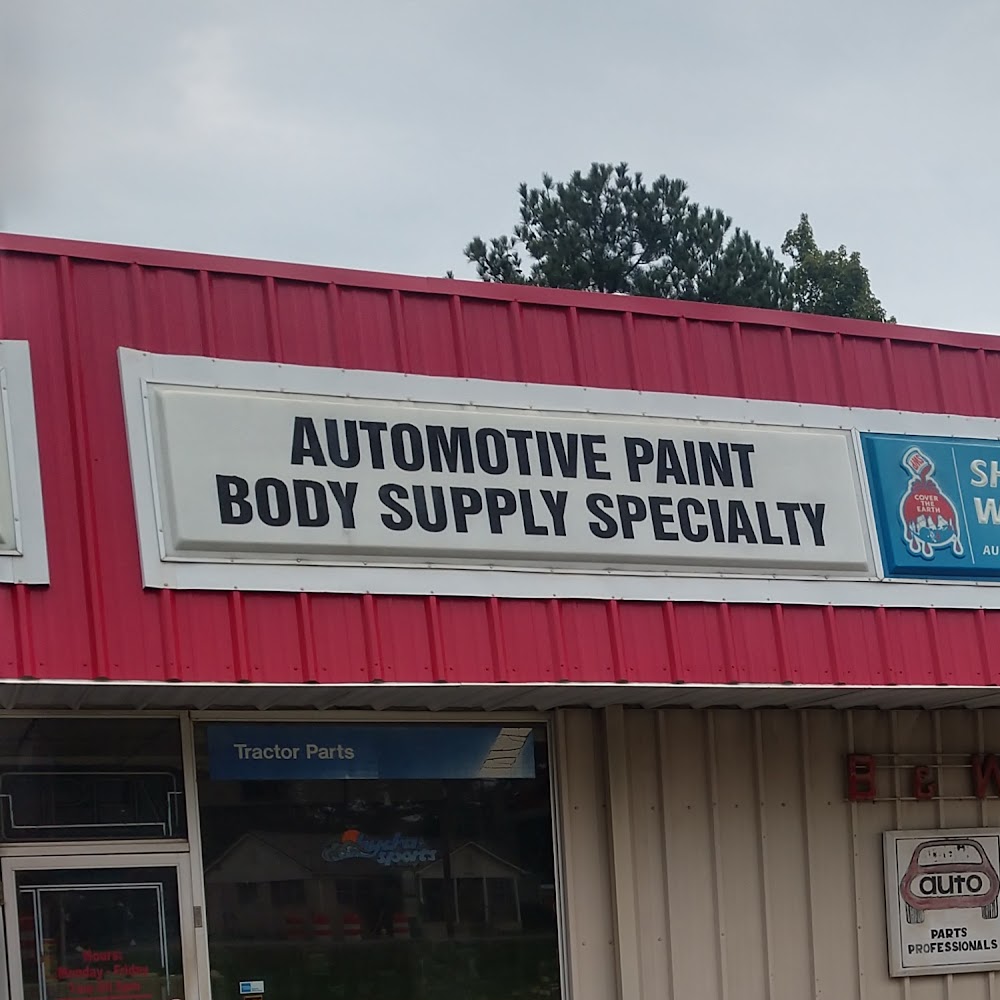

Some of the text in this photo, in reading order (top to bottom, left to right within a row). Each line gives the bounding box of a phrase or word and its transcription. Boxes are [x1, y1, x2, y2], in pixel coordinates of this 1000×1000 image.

[291, 416, 755, 488] AUTOMOTIVE PAINT
[215, 474, 826, 547] BODY SUPPLY SPECIALTY
[233, 744, 355, 759] Tractor Parts
[848, 753, 875, 800] B
[914, 766, 937, 799] &
[919, 874, 983, 895] auto
[931, 928, 967, 939] PARTS
[908, 939, 998, 954] PROFESSIONALS
[57, 966, 104, 980] Monday
[112, 964, 149, 977] Friday
